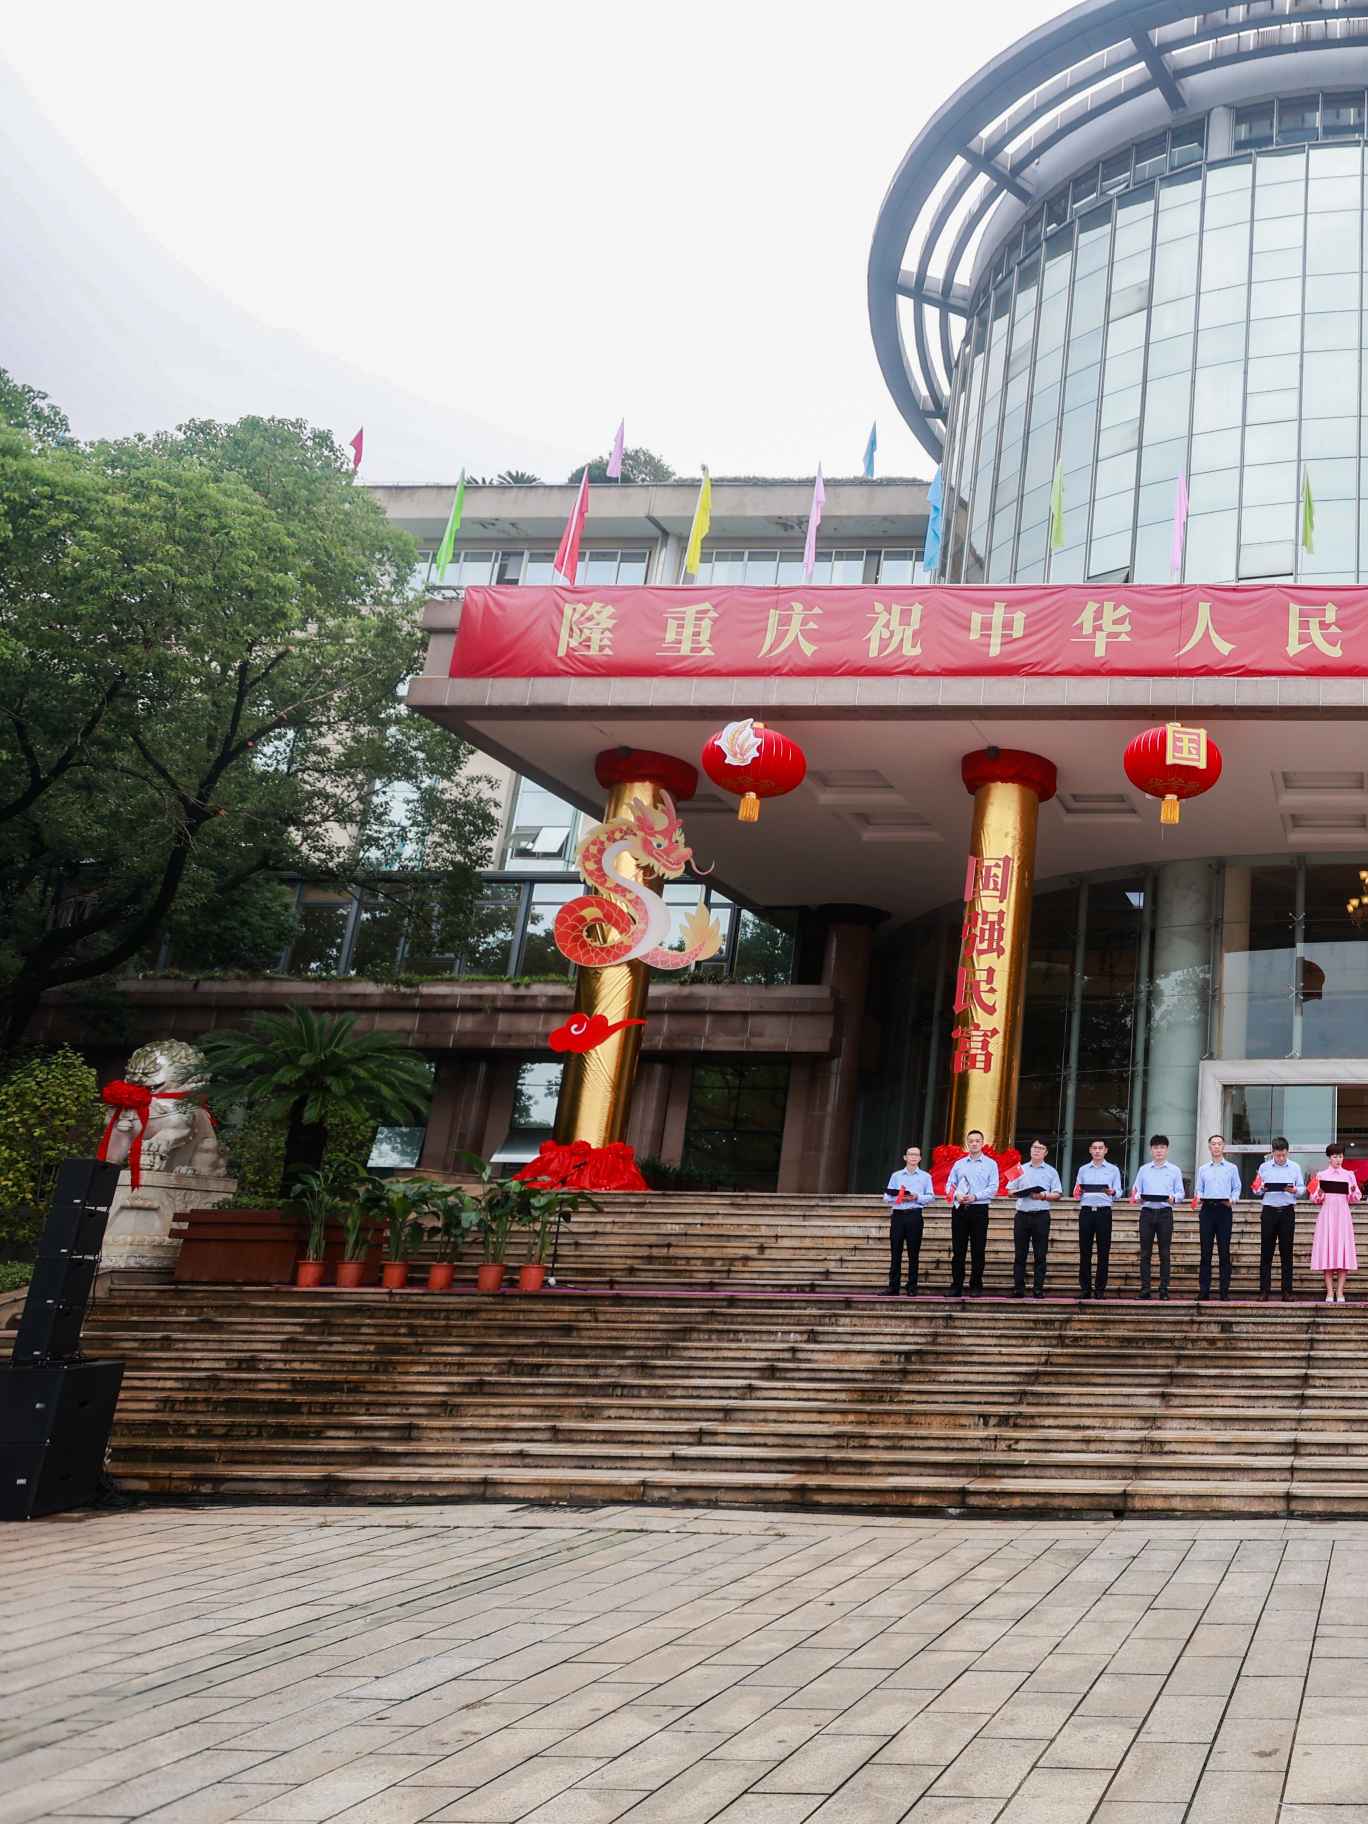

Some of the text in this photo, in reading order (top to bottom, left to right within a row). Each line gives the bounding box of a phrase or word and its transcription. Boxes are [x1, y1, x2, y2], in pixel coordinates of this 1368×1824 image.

[1166, 725, 1207, 769] 国
[952, 855, 1013, 1073] 国强民富
